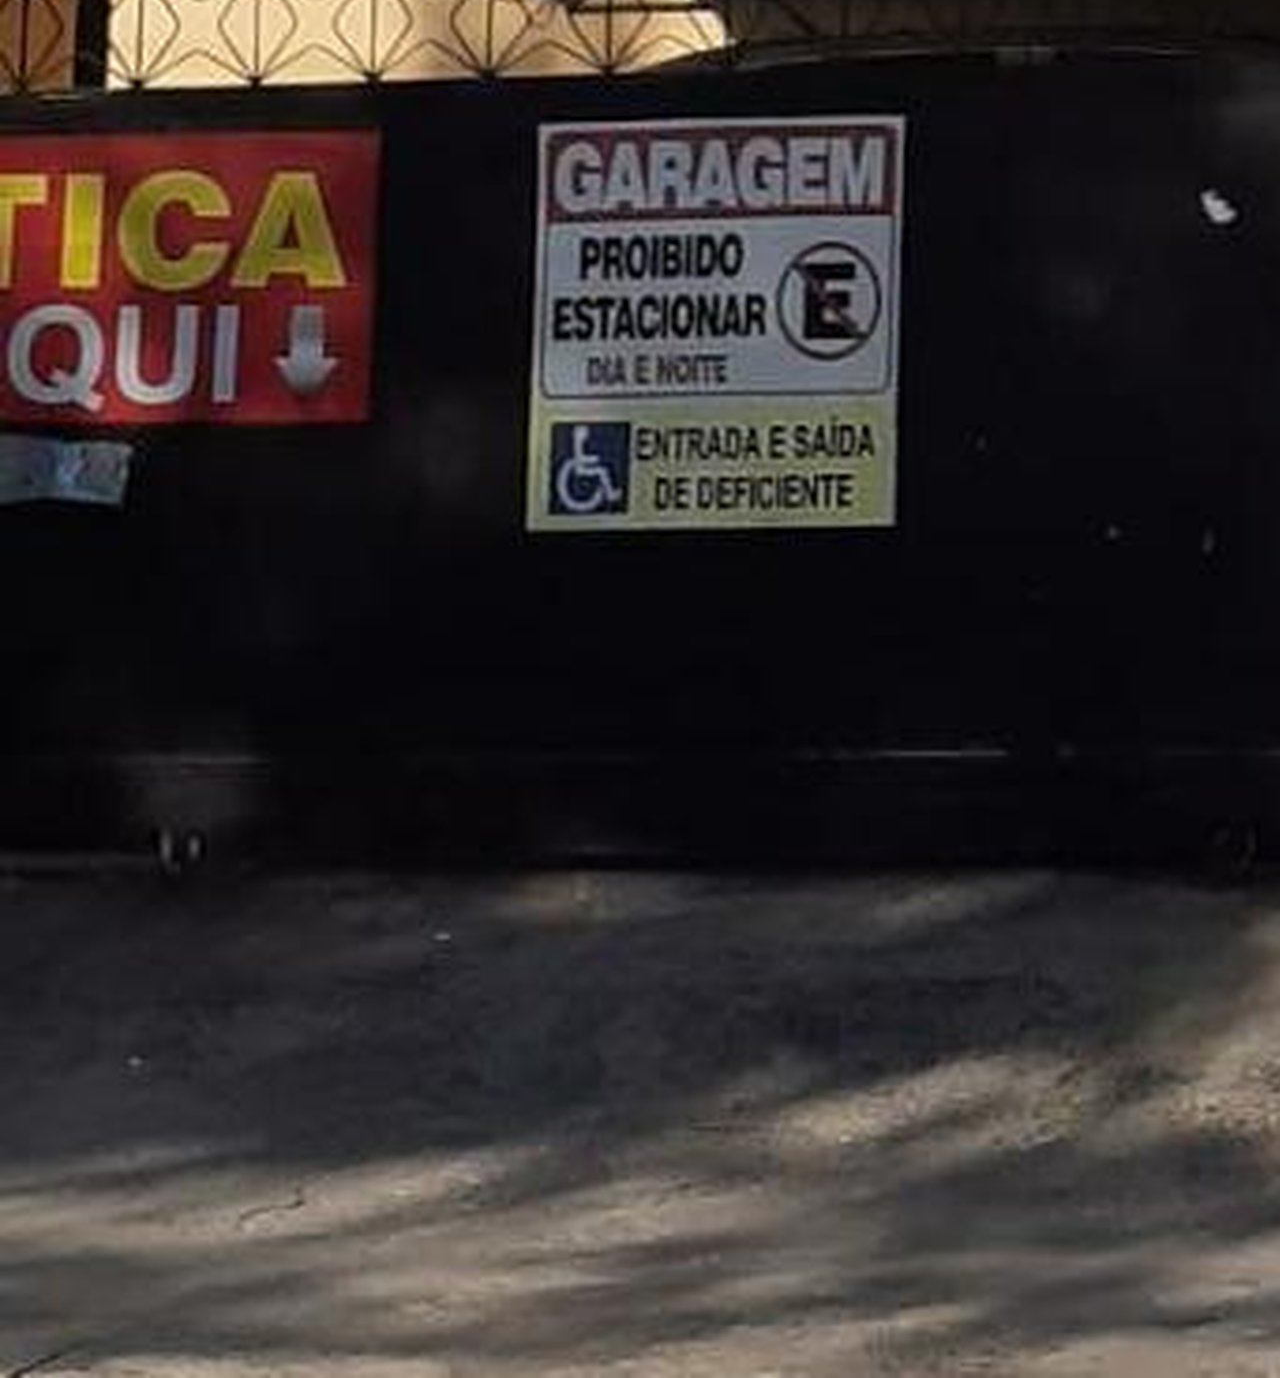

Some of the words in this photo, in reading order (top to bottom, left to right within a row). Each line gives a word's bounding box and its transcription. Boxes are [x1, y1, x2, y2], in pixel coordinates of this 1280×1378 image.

[552, 135, 887, 213] GARAGEM
[579, 231, 745, 281] PROIBIDO
[552, 293, 768, 342] ESTACIONAR
[586, 355, 627, 386] DIA
[635, 355, 650, 385] E
[655, 354, 729, 385] NOITE
[635, 425, 762, 462] ENTRADA
[769, 424, 787, 460] E
[792, 415, 876, 458] SAÍDA
[653, 477, 695, 511] DE
[698, 473, 856, 510] DEFICIENTE
